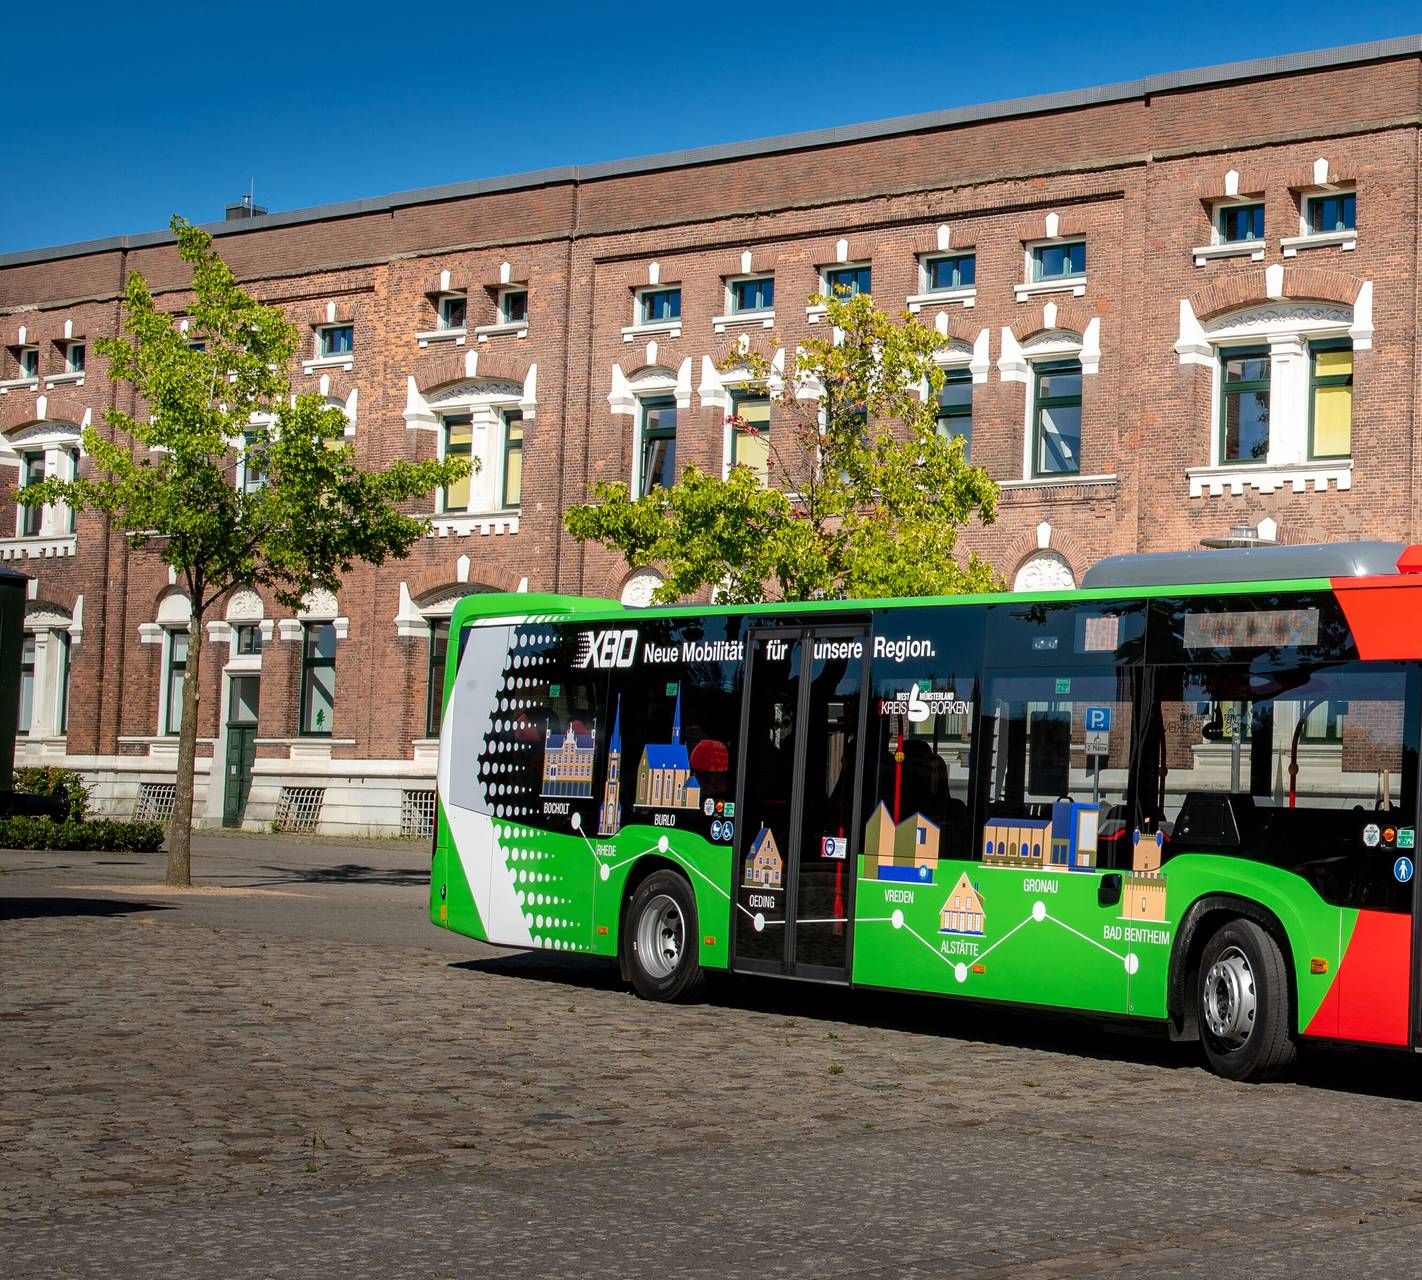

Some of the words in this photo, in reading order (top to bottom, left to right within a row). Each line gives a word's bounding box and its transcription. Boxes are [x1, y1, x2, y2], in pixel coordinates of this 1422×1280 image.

[576, 629, 639, 669] X80
[643, 643, 679, 664] Neue
[682, 640, 744, 663] Mobilität
[766, 639, 788, 661] für
[813, 642, 863, 660] unsere
[873, 636, 936, 662] Region.
[896, 692, 911, 701] WEST
[919, 690, 955, 701] MÜNSTERLAND
[880, 701, 908, 715] KREIS
[930, 701, 970, 715] BORKEN
[543, 802, 571, 815] BOCHOLT
[654, 813, 676, 827] BURLO
[597, 844, 617, 857] RHEDE
[1023, 878, 1059, 894] GRONAU
[749, 894, 775, 908] OEDING
[884, 889, 914, 904] VREDEN
[1103, 925, 1122, 941] BAD
[1124, 927, 1171, 945] BENTHEIM
[940, 939, 979, 957] ALSTÄTTE
